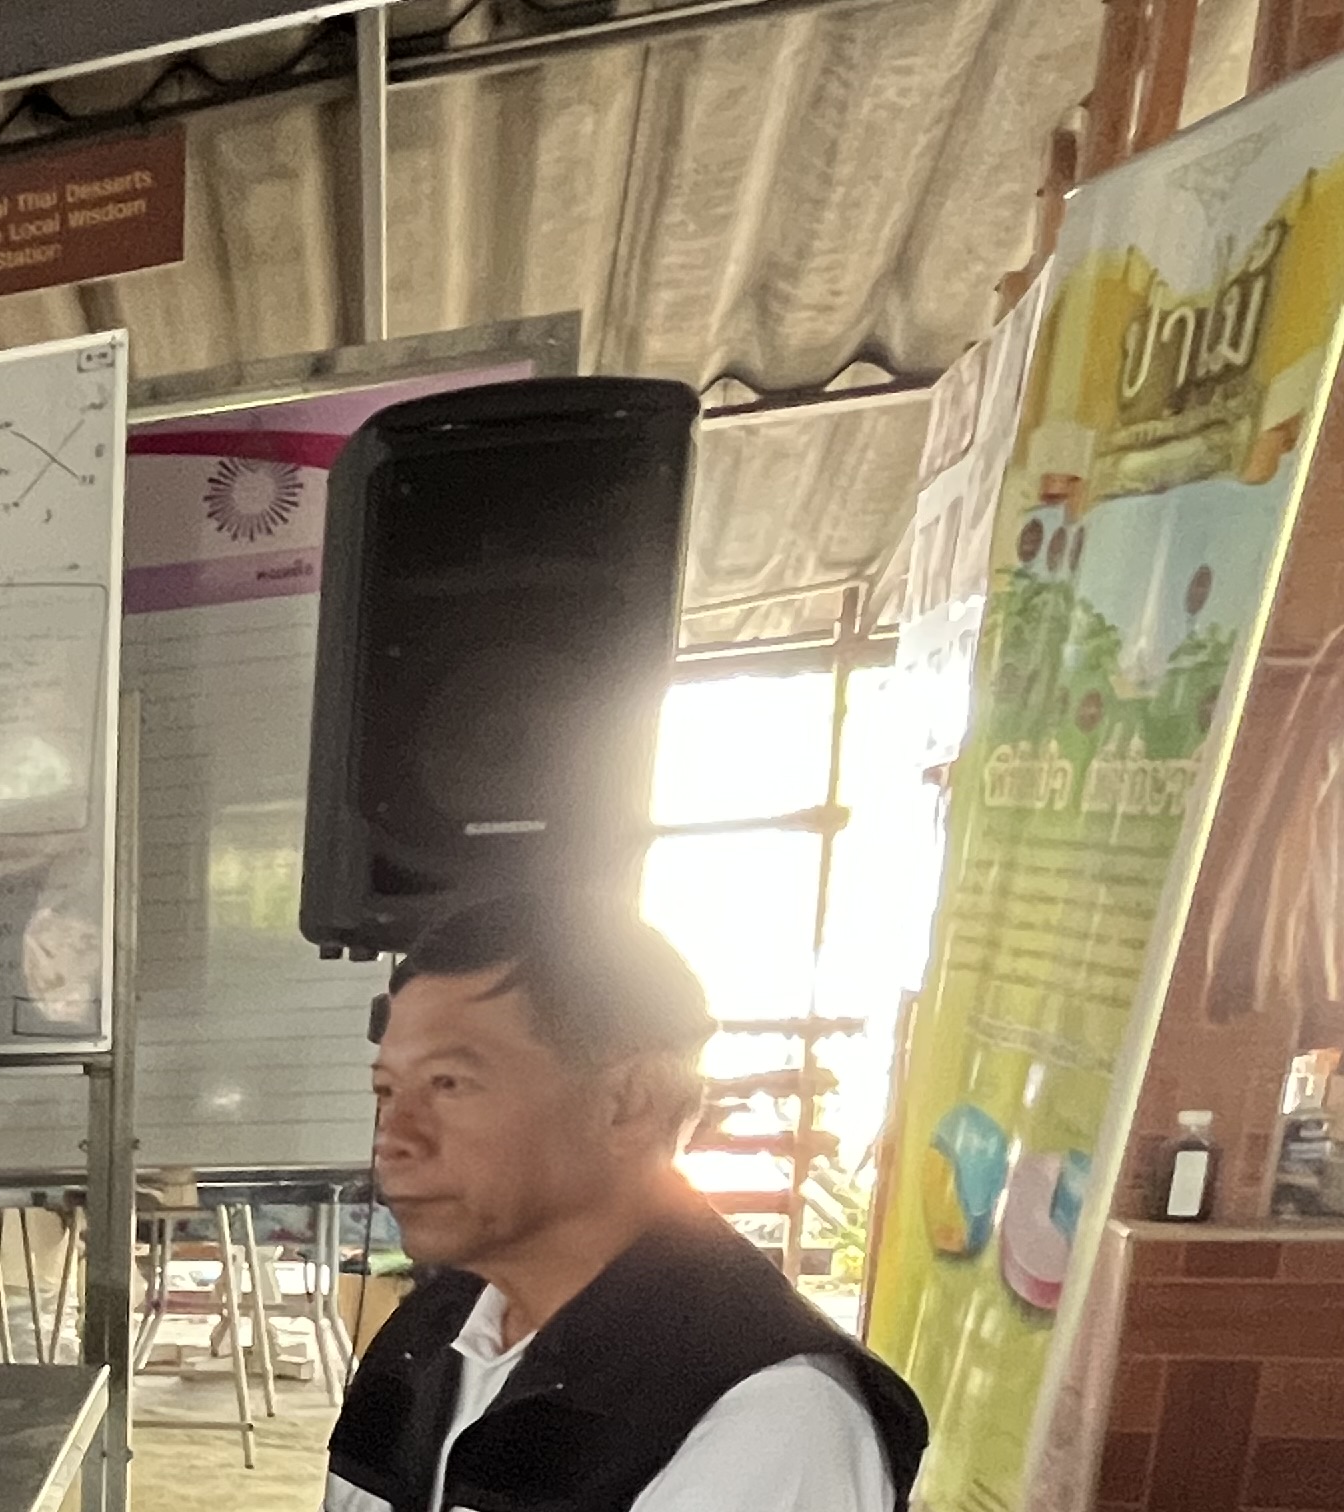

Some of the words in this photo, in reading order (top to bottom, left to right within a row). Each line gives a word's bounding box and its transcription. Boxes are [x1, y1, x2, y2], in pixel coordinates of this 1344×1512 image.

[16, 188, 58, 212] Thai
[65, 169, 154, 203] Desserts
[7, 213, 61, 241] Local
[68, 198, 148, 229] Wisdom
